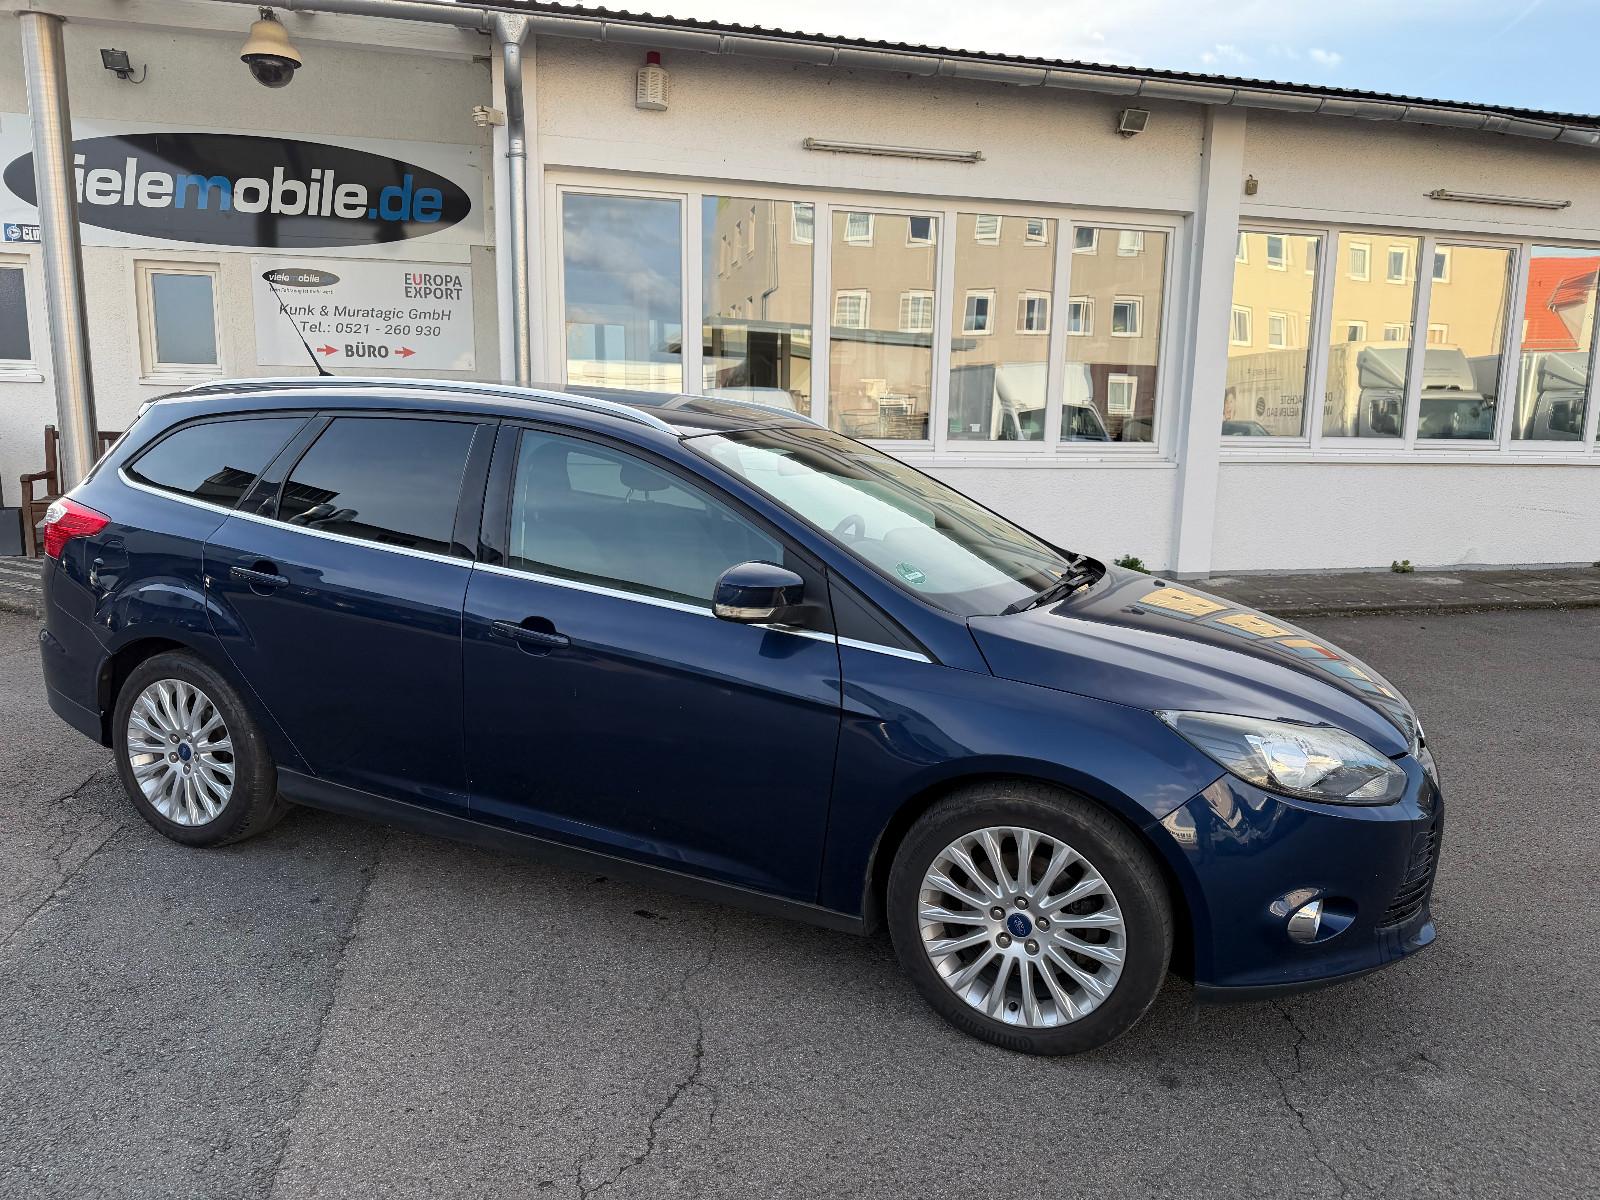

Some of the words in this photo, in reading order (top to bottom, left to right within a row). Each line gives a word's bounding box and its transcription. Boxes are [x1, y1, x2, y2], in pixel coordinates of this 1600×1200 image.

[74, 153, 444, 224] ielemobile.de
[404, 272, 463, 288] EUROPA
[404, 286, 463, 301] EXPORT
[279, 303, 315, 316] Kunk
[319, 305, 329, 317] &
[333, 305, 404, 321] Muratagic
[408, 308, 452, 321] GmbH
[300, 321, 330, 334] Tel.:
[335, 323, 370, 334] 0521
[384, 324, 410, 336] 260
[415, 325, 441, 337] 930
[344, 342, 389, 359] BÜRO
